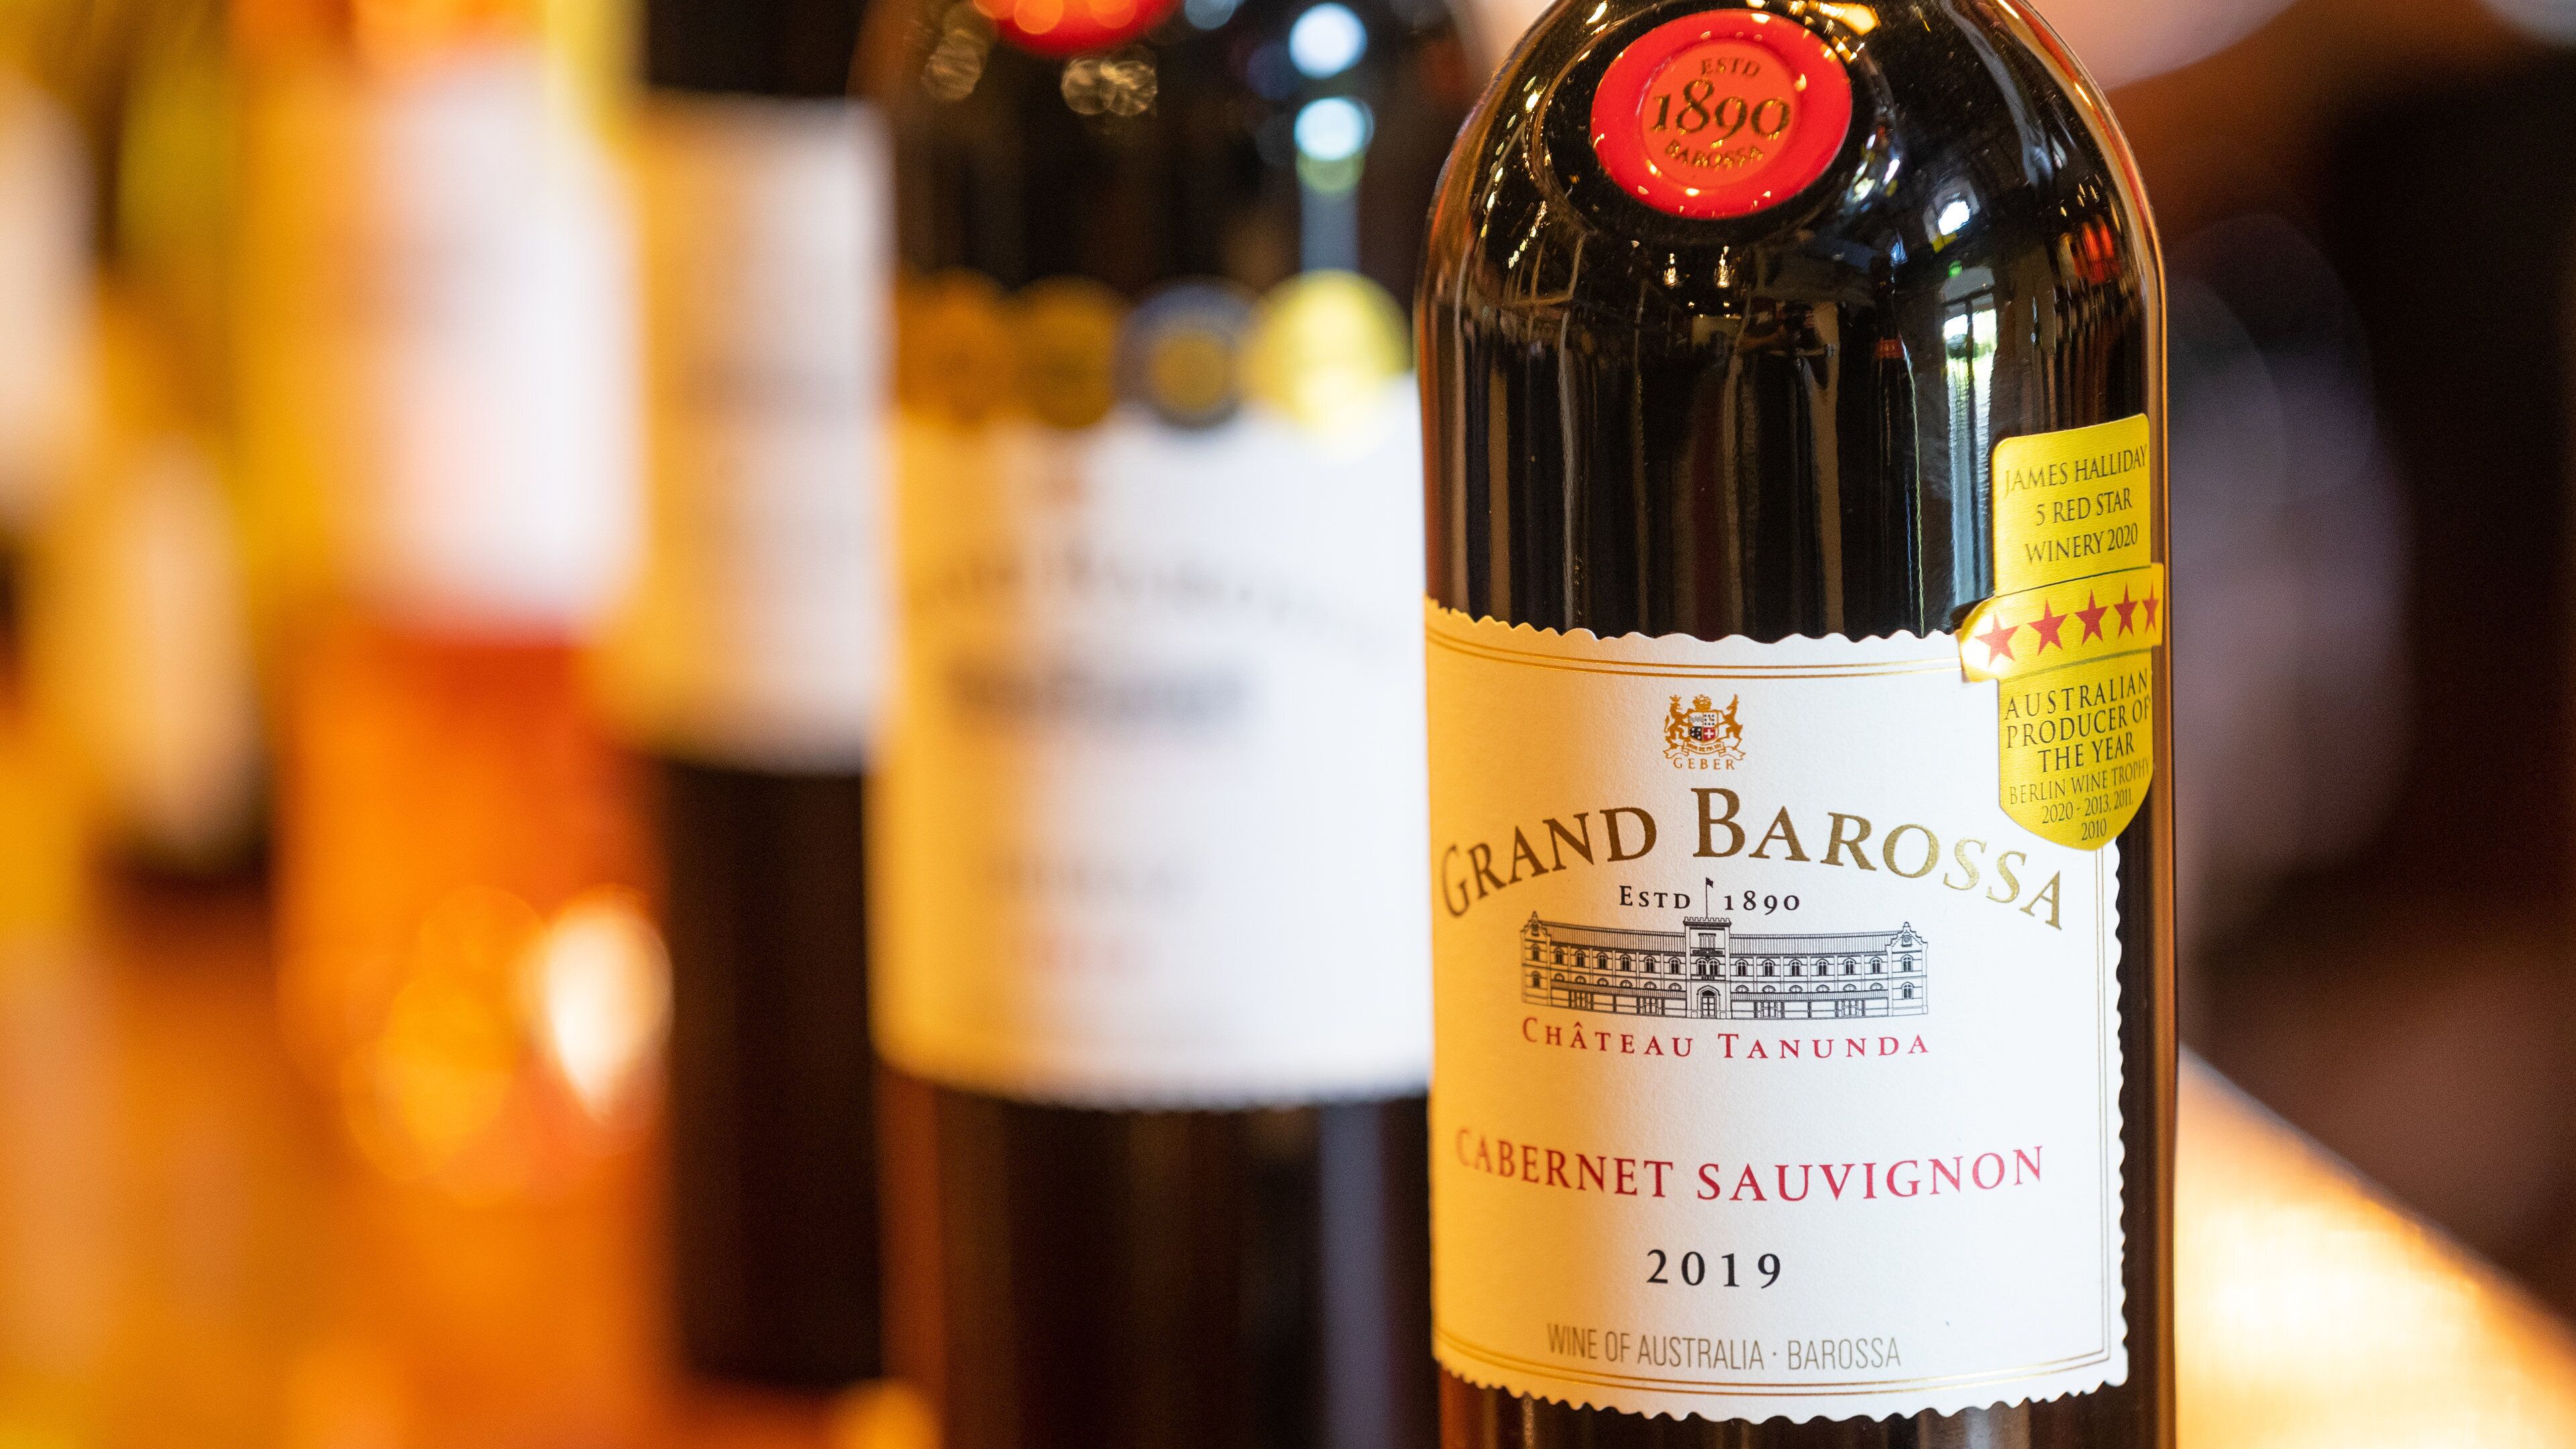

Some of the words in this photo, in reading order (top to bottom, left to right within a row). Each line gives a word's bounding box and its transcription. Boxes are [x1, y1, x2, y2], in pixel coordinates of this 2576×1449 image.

[1701, 58, 1760, 76] ESTD
[1651, 78, 1790, 148] 1890
[2004, 462, 2068, 498] JAMES
[2074, 443, 2147, 482] HALLIDAY
[2036, 504, 2045, 526] 5
[2053, 497, 2091, 523] RED
[2096, 488, 2133, 515] STAR
[2025, 531, 2104, 564] WINERY
[2107, 523, 2138, 551] 2020
[2004, 668, 2147, 720] AUSTRALIAN
[2006, 705, 2127, 749] PRODUCER
[2132, 695, 2151, 723] OF
[1673, 757, 1735, 770] GEBER
[2038, 743, 2084, 773] THE
[2092, 732, 2135, 763] YEAR
[2009, 778, 2065, 805] BERLIN
[2071, 771, 2108, 794] WINE
[2112, 755, 2151, 787] TROPHY
[2041, 804, 2074, 824] 2020
[2081, 818, 2107, 841] 2010
[1441, 806, 1658, 918] GRAND
[1690, 788, 2062, 931] BAROSSA
[1619, 885, 1691, 909] ESTD
[1724, 890, 1801, 916] 1890
[1522, 1017, 1694, 1057] CHÂTEAU
[1718, 1033, 1929, 1059] TANUNDA
[1455, 1127, 1674, 1199] CABERNET
[1697, 1146, 2043, 1202] SAUVIGNON
[1646, 1248, 1782, 1289] 2019
[1547, 1323, 1598, 1360] WINE
[1605, 1330, 1631, 1363] OF
[1637, 1334, 1764, 1371] AUSTRALIA
[1788, 1337, 1901, 1371] BAROSSA
